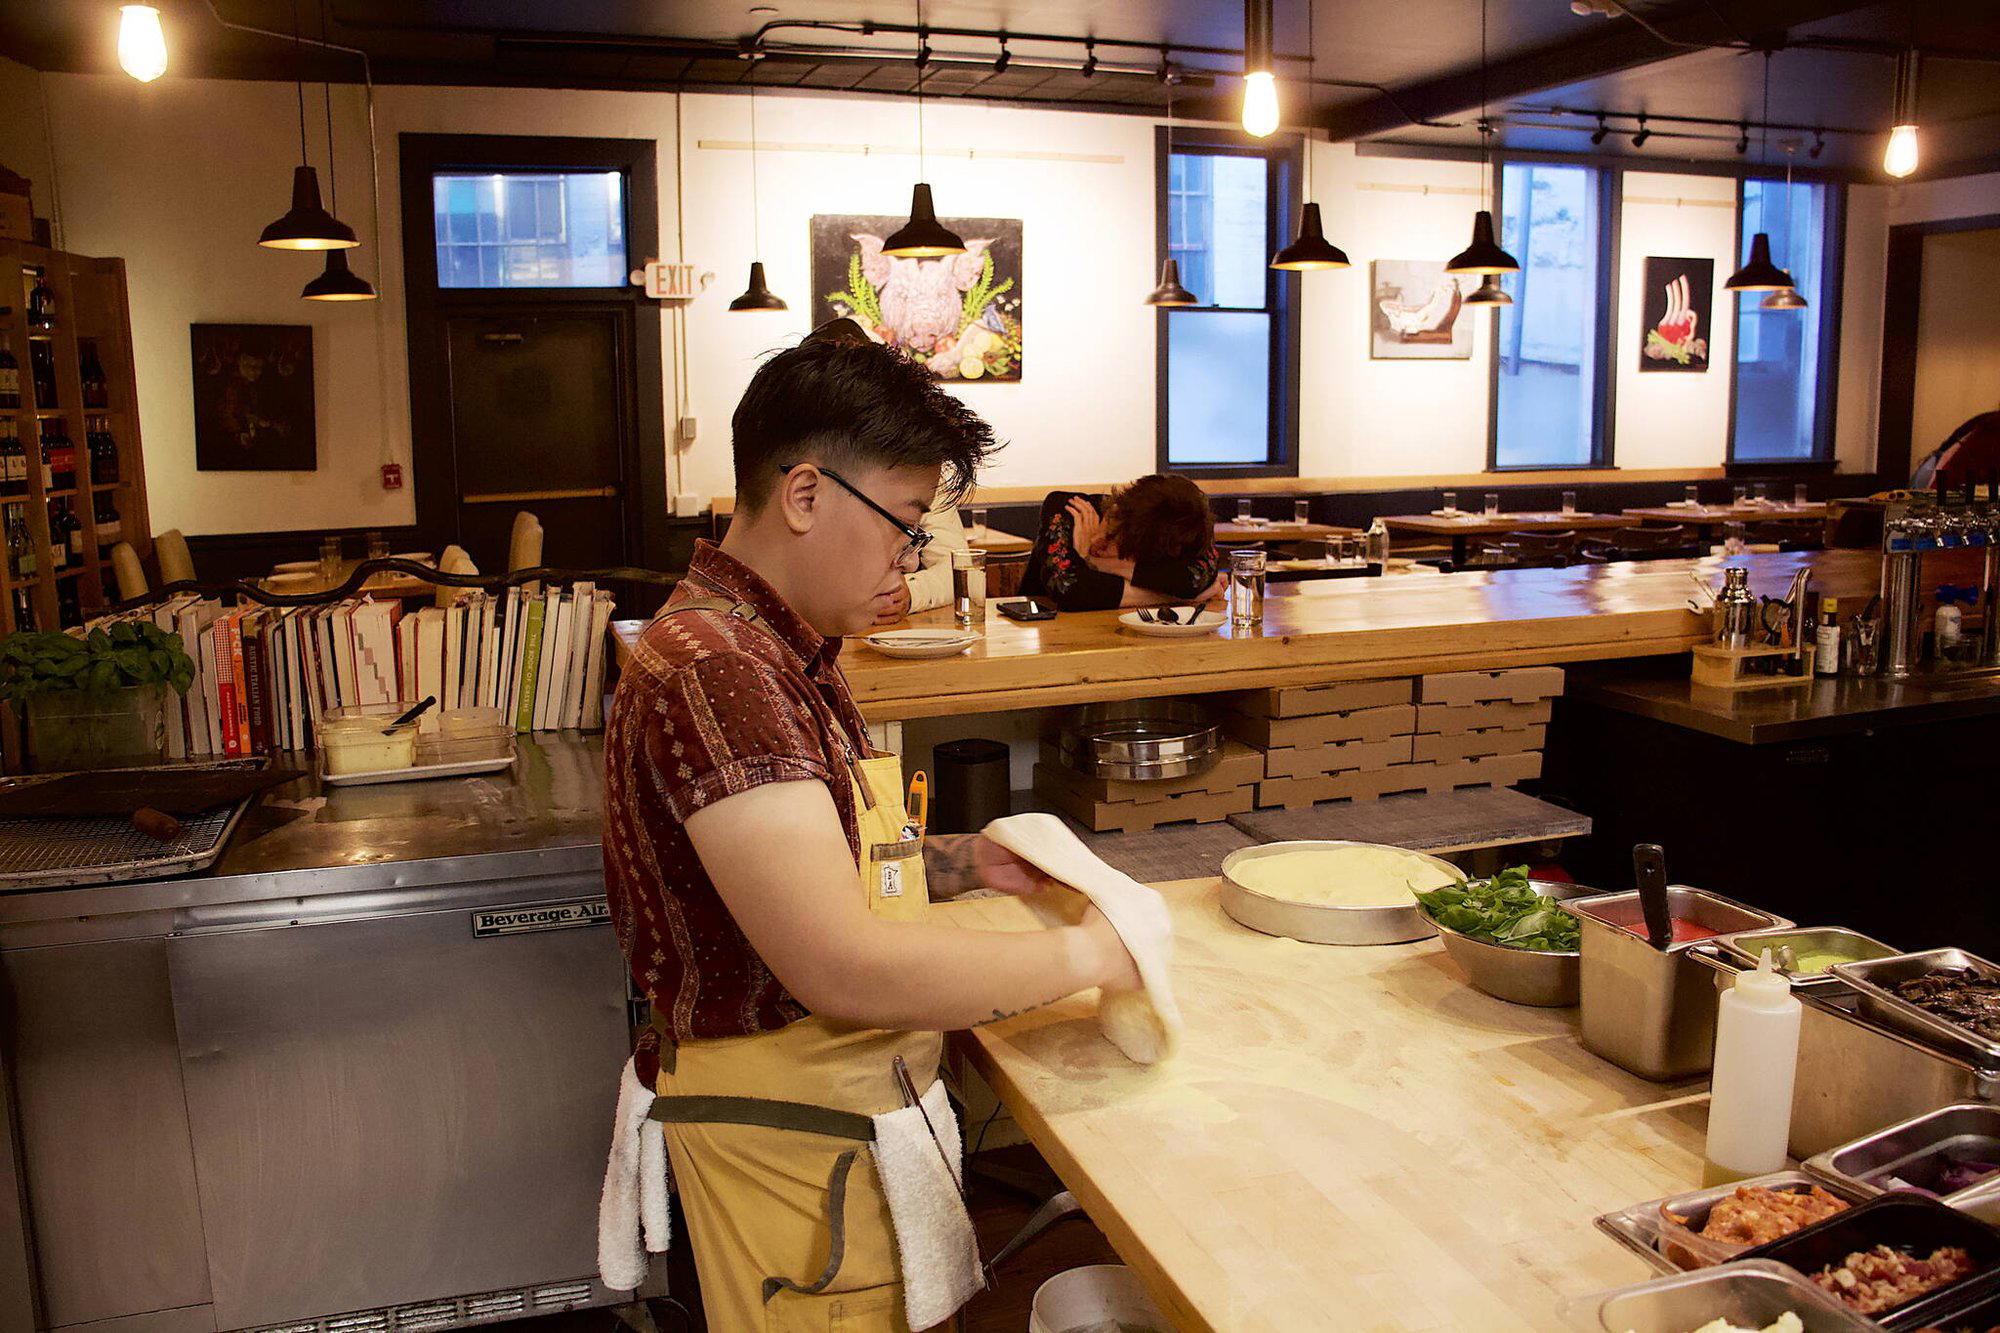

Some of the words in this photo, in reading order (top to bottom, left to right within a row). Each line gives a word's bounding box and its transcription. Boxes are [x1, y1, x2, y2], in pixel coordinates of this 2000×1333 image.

[656, 264, 694, 295] EXIT
[251, 674, 259, 704] ITALIAN
[253, 706, 261, 726] FOOD
